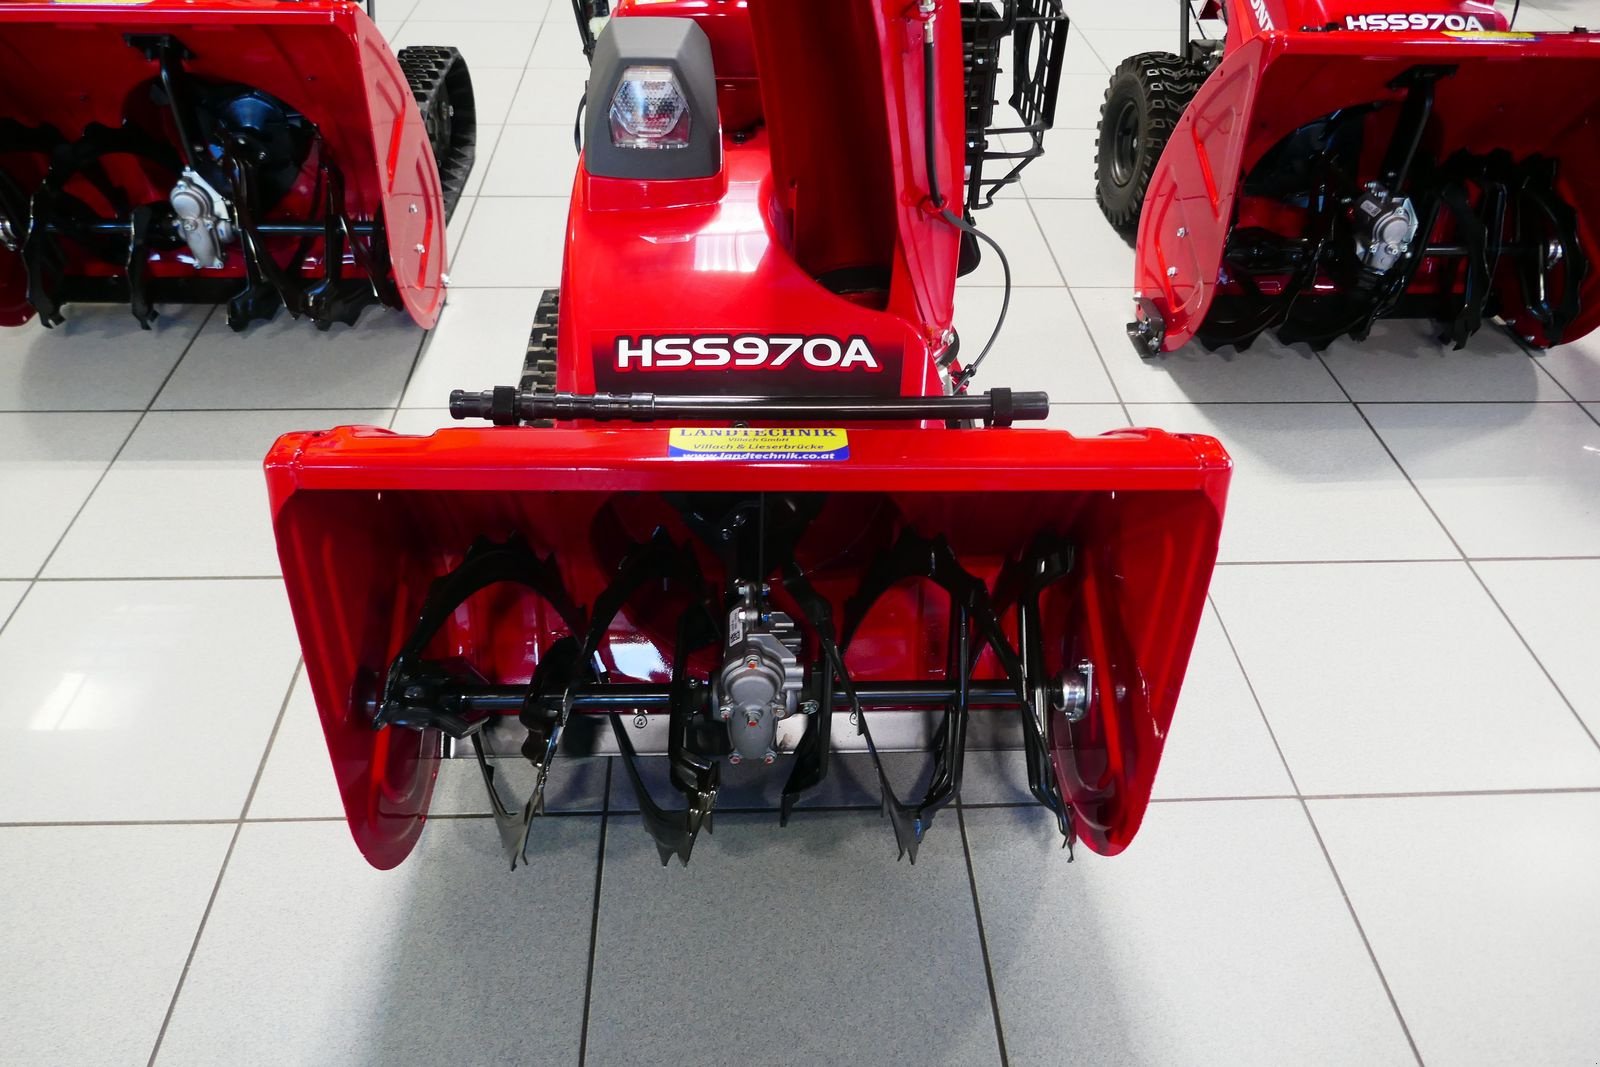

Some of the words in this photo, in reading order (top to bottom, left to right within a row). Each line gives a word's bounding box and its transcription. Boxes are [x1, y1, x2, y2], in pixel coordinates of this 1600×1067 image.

[1345, 14, 1484, 31] HSS970A
[618, 337, 878, 368] HSS970A
[681, 429, 837, 437] LANDTECHNIK
[682, 452, 835, 460] www.landtechnik.co.at
